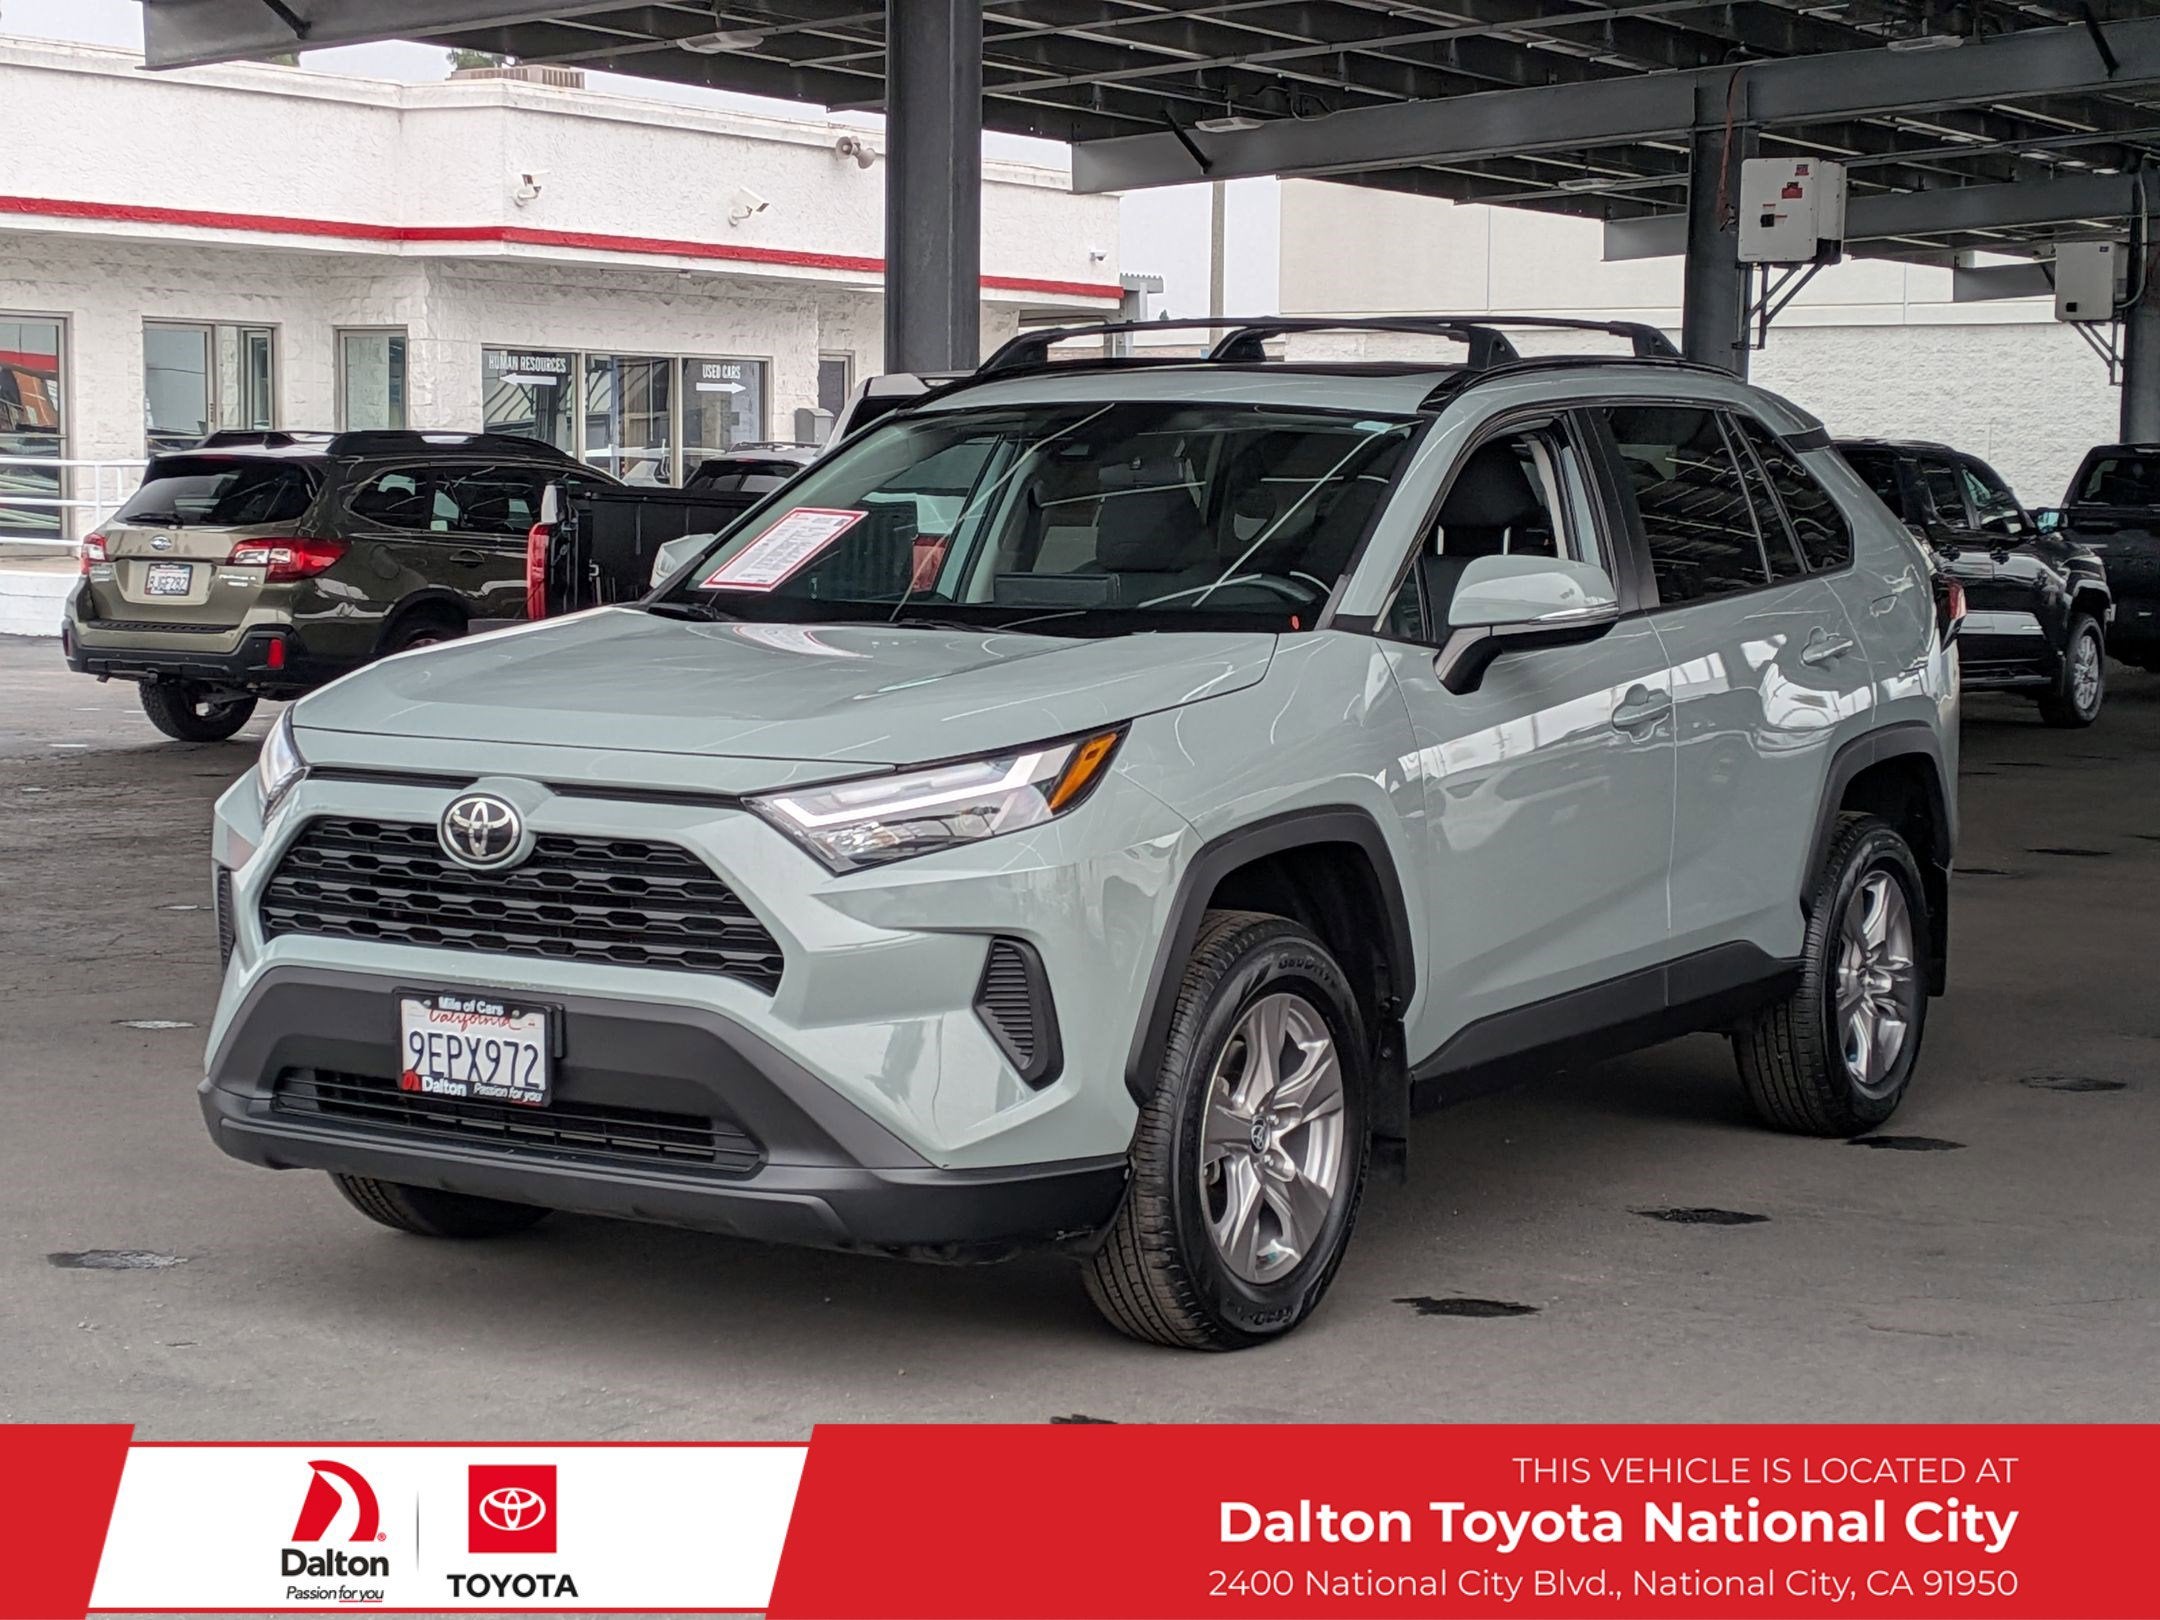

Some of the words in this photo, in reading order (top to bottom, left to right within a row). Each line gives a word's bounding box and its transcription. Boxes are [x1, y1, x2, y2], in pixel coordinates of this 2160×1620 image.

[489, 355, 519, 371] HUMAN
[520, 356, 567, 373] RESOURCES
[702, 363, 721, 379] USED
[722, 364, 741, 380] CARS
[438, 996, 461, 1011] Mile
[463, 1000, 475, 1012] of
[476, 1001, 504, 1015] Cars
[409, 1030, 540, 1089] 9EPX972
[422, 1076, 467, 1097] Dalton
[473, 1083, 508, 1098] Passion
[509, 1086, 524, 1099] for
[523, 1090, 544, 1103] you
